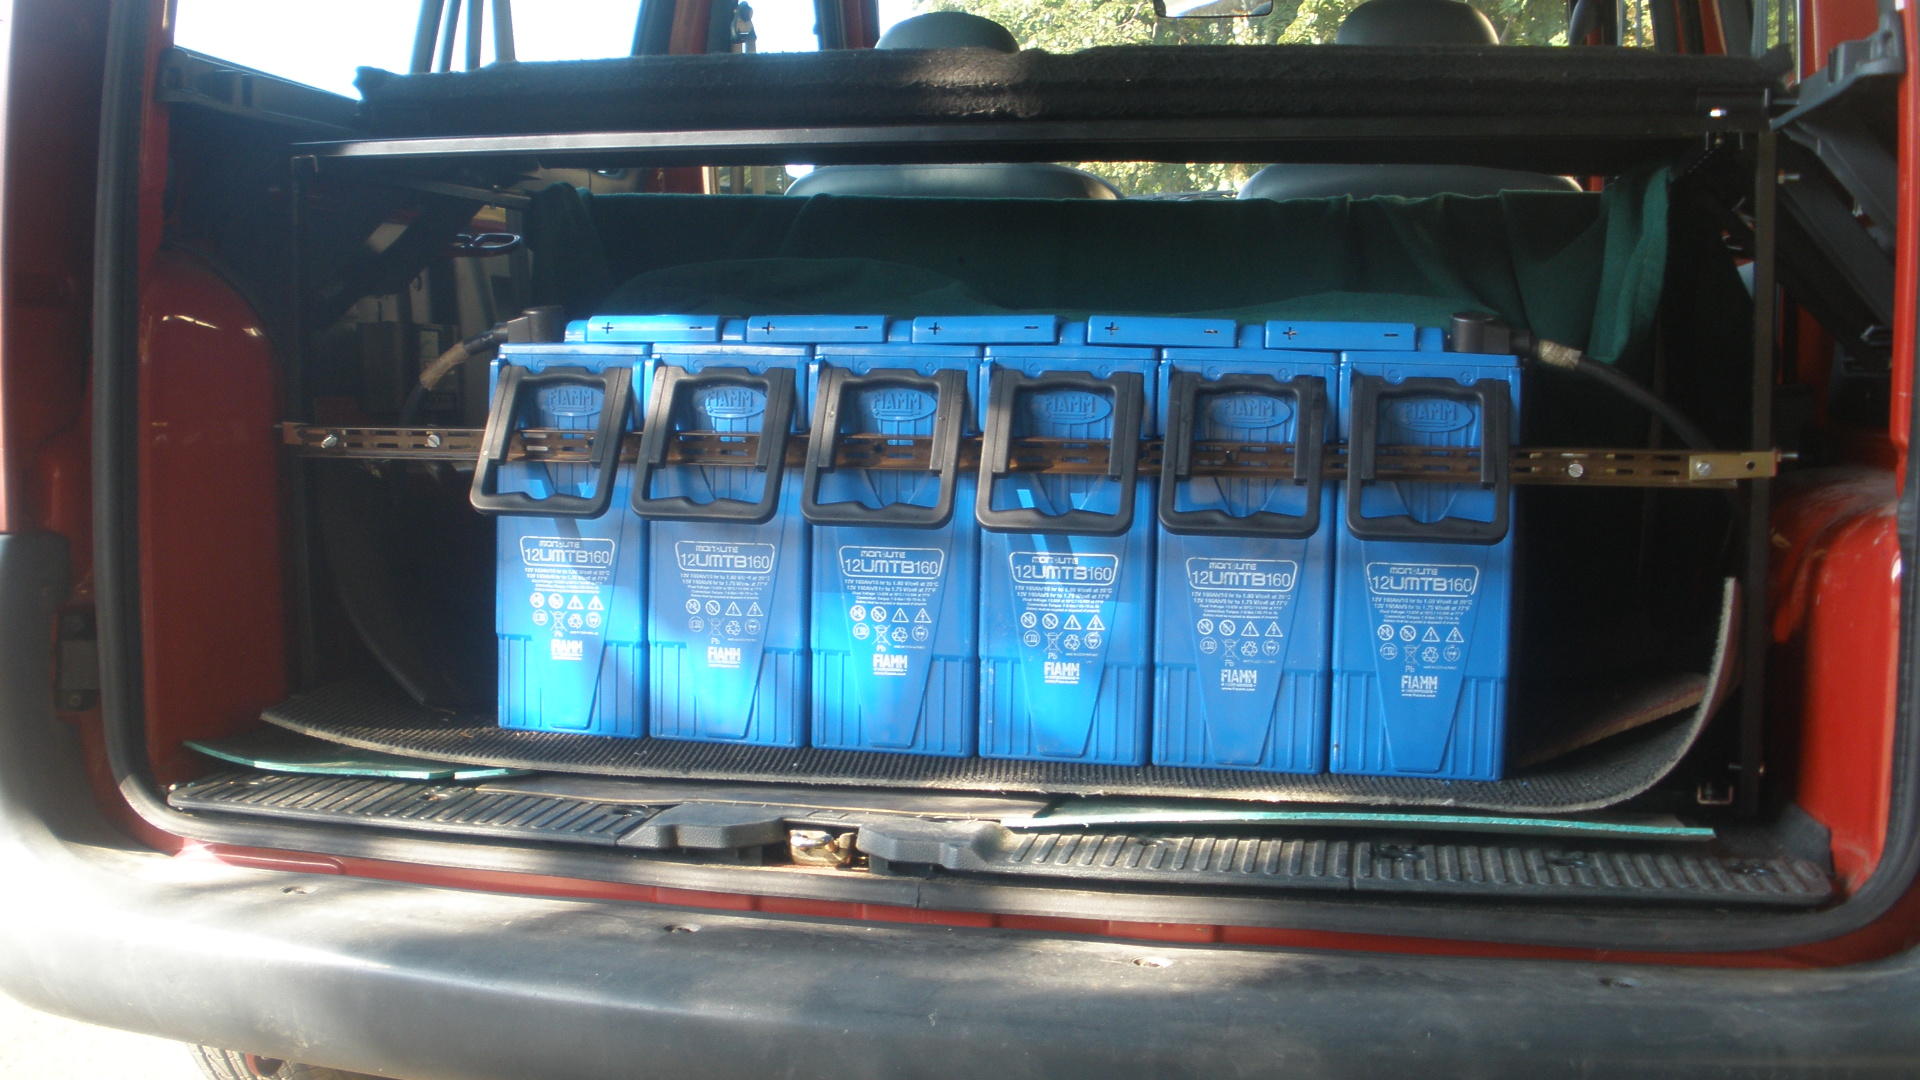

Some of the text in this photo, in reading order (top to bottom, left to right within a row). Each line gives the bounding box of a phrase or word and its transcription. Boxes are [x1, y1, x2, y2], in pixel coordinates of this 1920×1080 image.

[551, 389, 594, 407] FIAMM
[874, 390, 922, 409] FIAMM
[1046, 392, 1096, 413] FIAMM
[1225, 398, 1275, 417] FIAMM
[1405, 401, 1457, 421] FIAMM
[872, 654, 907, 668] FIAMM
[1044, 662, 1079, 676] FIAMM
[1220, 669, 1257, 684] FIAMM
[1401, 675, 1438, 690] FIAMM
